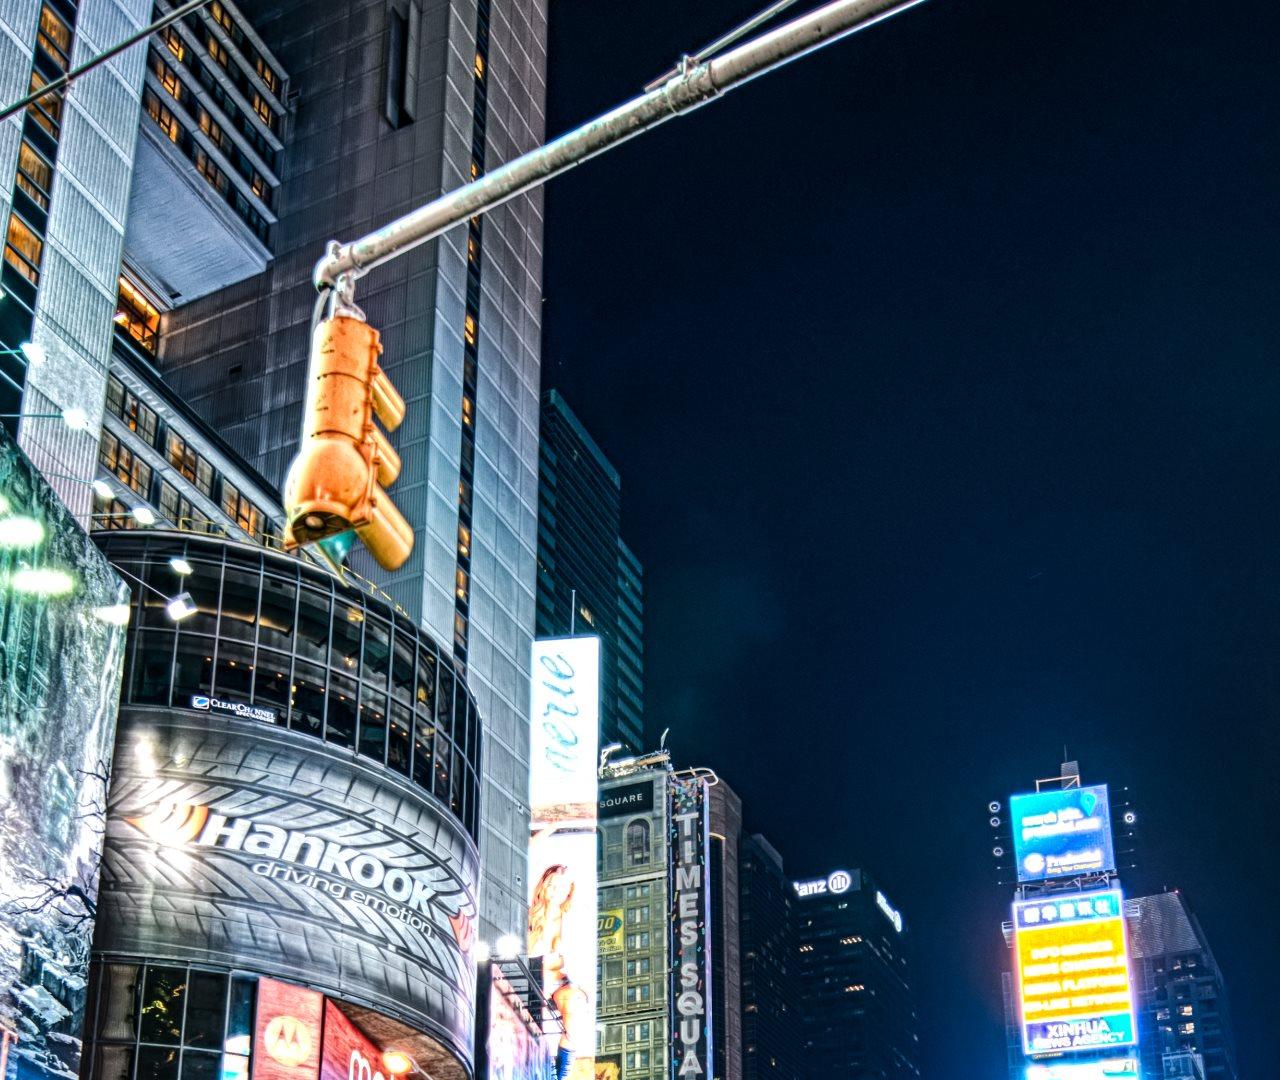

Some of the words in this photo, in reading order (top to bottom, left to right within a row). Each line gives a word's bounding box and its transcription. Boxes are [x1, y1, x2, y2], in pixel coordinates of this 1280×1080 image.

[599, 793, 644, 809] SQUARE
[252, 861, 346, 898] driving
[350, 889, 434, 937] emotion
[674, 811, 702, 947] TIMES
